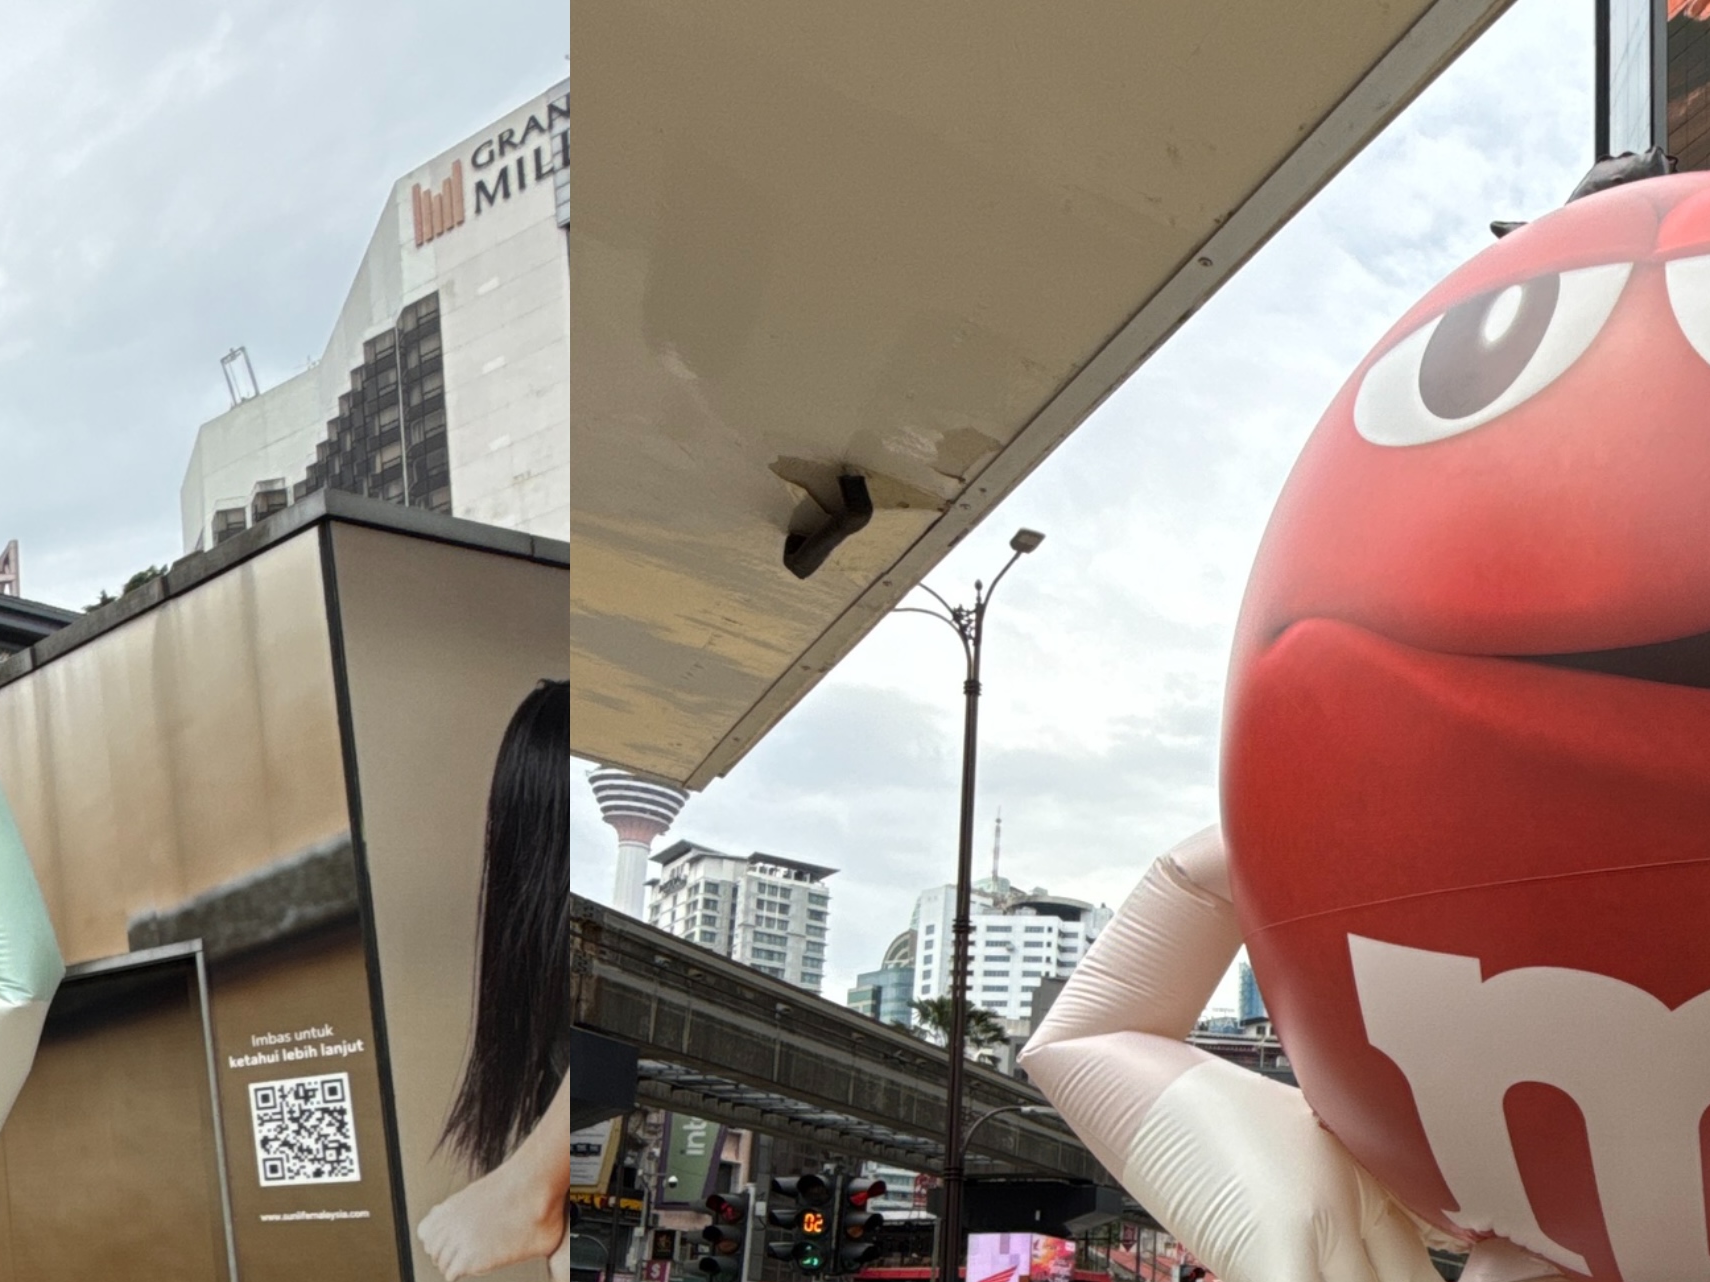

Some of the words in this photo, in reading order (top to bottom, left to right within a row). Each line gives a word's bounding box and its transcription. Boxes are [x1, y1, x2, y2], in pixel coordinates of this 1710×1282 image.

[251, 1031, 291, 1047] Imbas
[294, 1023, 334, 1041] untuk
[229, 1051, 279, 1069] ketahui
[282, 1047, 318, 1063] lebih
[321, 1038, 364, 1059] lanjut
[804, 1213, 823, 1233] 02
